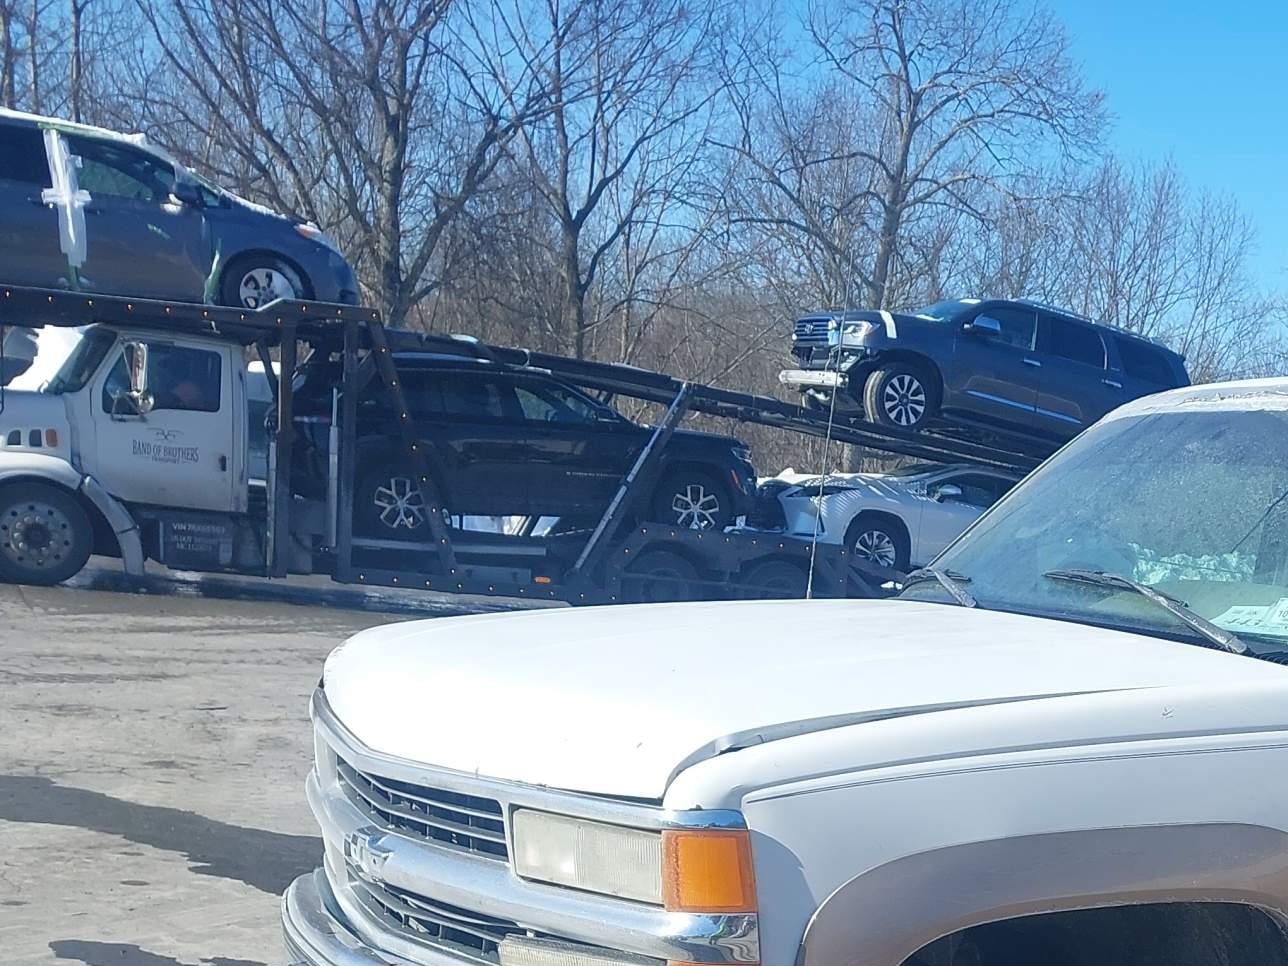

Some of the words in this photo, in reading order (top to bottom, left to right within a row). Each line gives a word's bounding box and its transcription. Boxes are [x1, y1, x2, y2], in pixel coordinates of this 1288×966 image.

[133, 440, 152, 456] BAND
[153, 444, 161, 457] OF
[164, 446, 199, 463] BROTHERS
